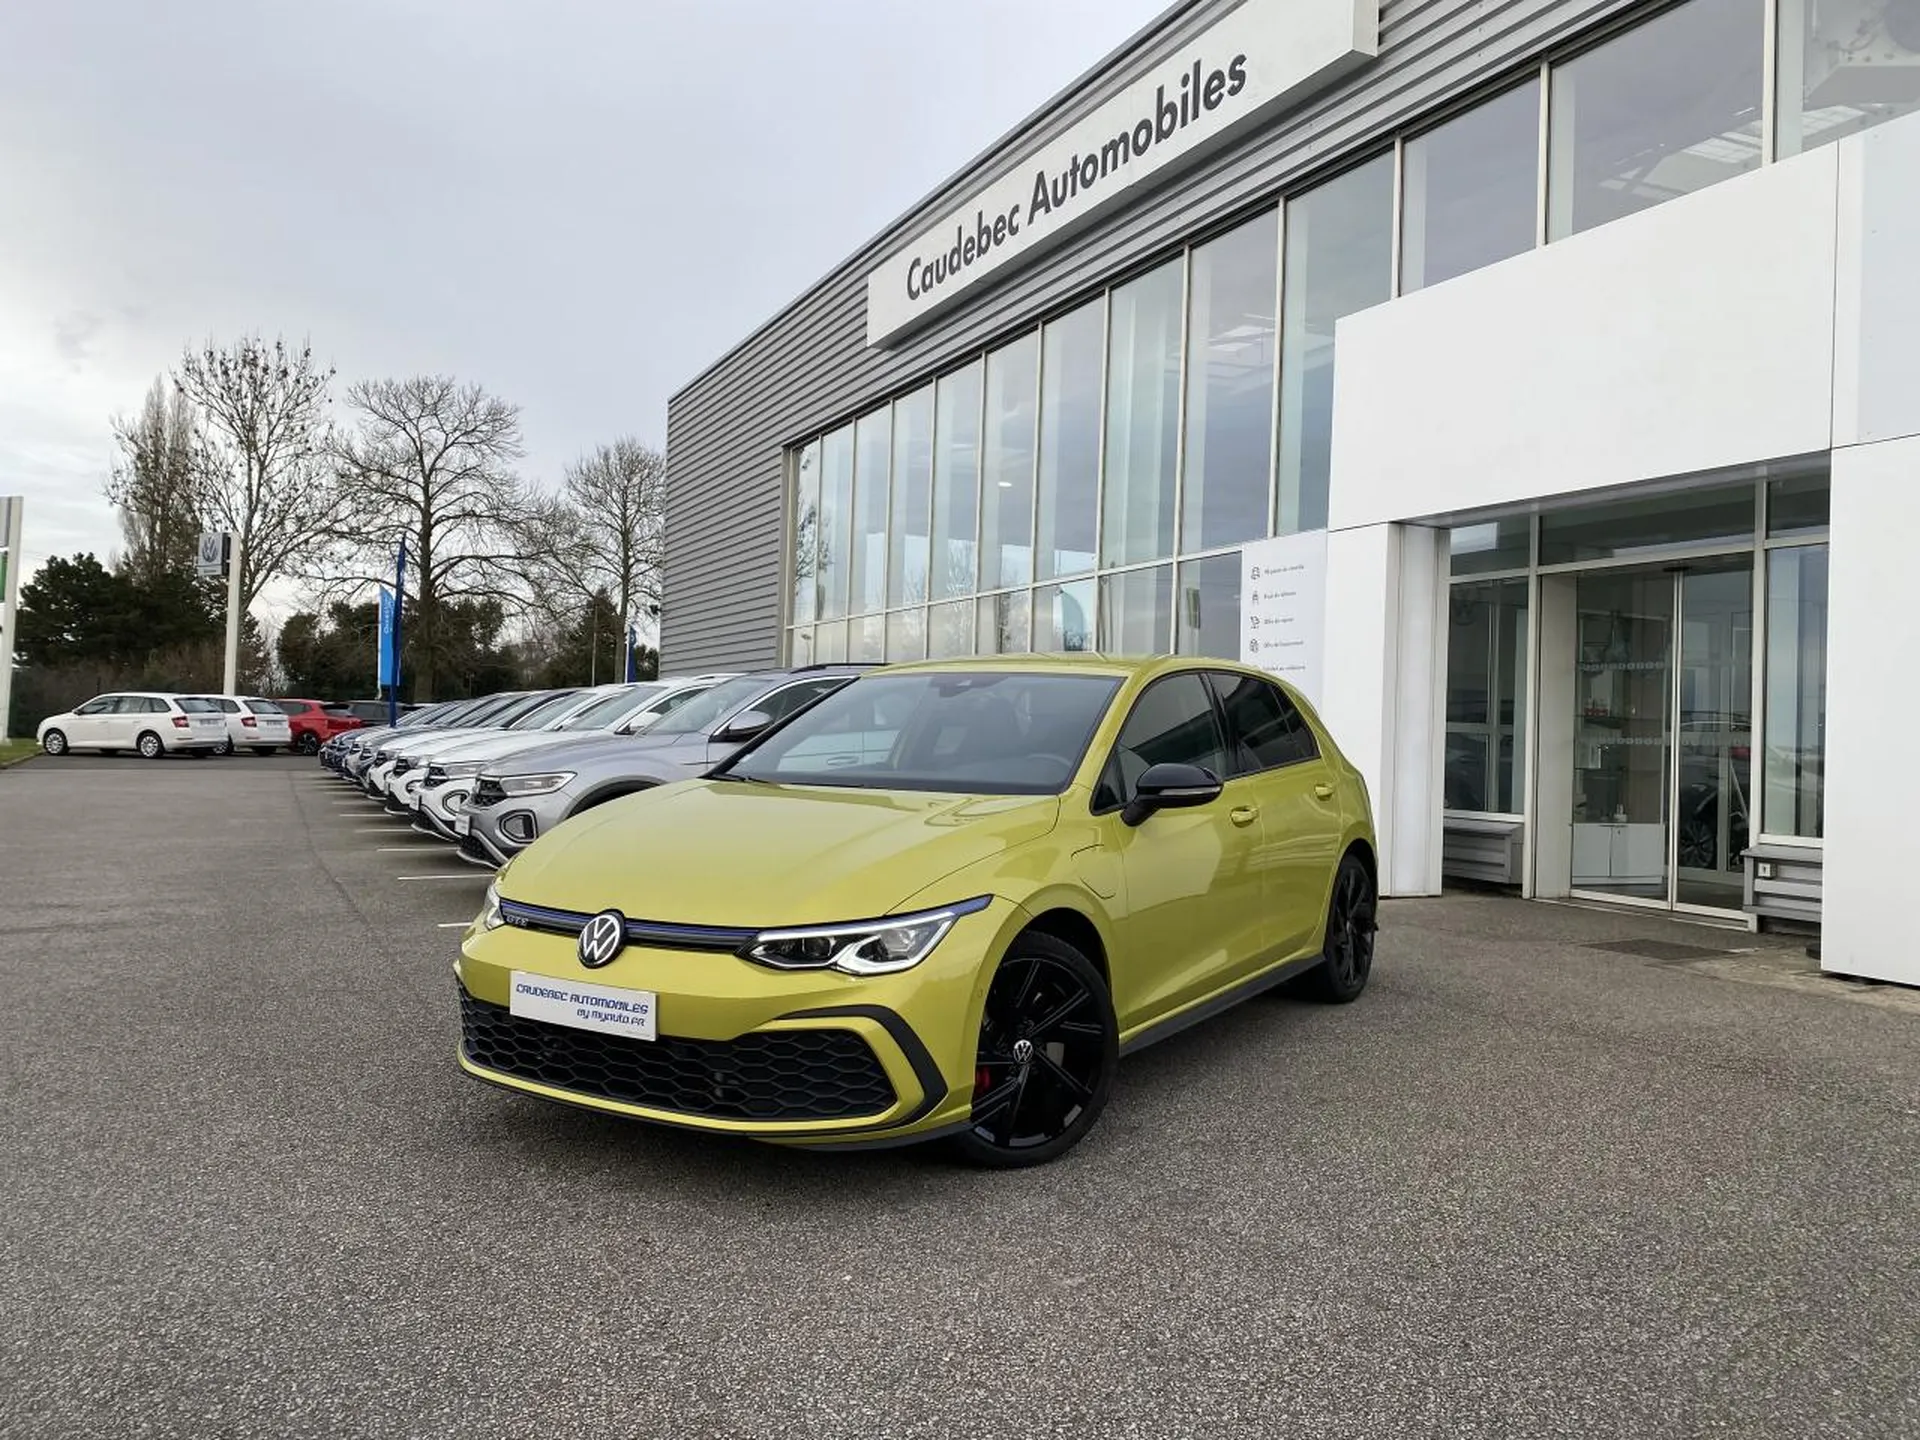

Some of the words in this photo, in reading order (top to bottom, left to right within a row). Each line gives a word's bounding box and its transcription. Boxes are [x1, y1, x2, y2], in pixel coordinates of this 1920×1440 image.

[907, 202, 1020, 301] Caudebec
[1027, 53, 1248, 224] Automobiles
[516, 983, 569, 1001] CAUDEBEC
[570, 994, 648, 1014] AUTOMOBILES
